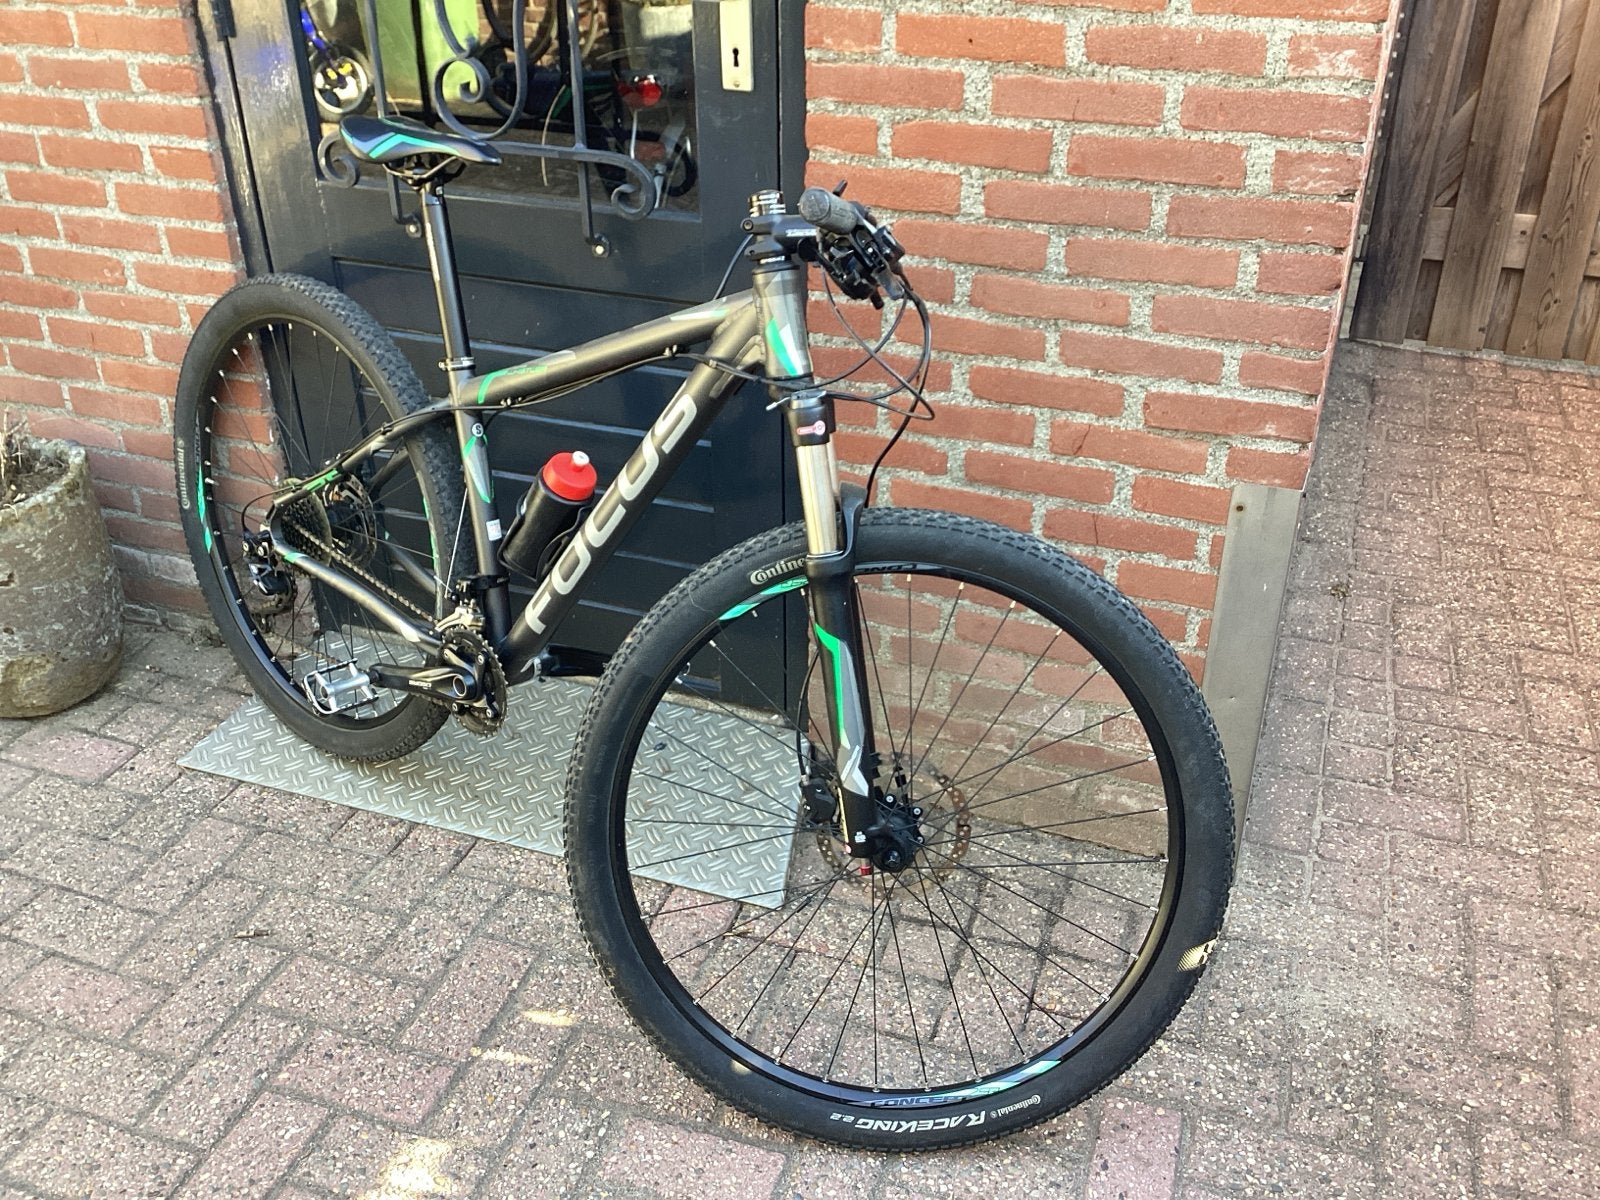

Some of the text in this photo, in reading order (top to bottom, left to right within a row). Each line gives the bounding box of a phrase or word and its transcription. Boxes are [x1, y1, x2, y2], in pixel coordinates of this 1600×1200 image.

[475, 424, 482, 434] S
[525, 381, 698, 635] FOCUS
[750, 557, 805, 585] Contine
[829, 1094, 1042, 1133] Continental RACEKING 2.2
